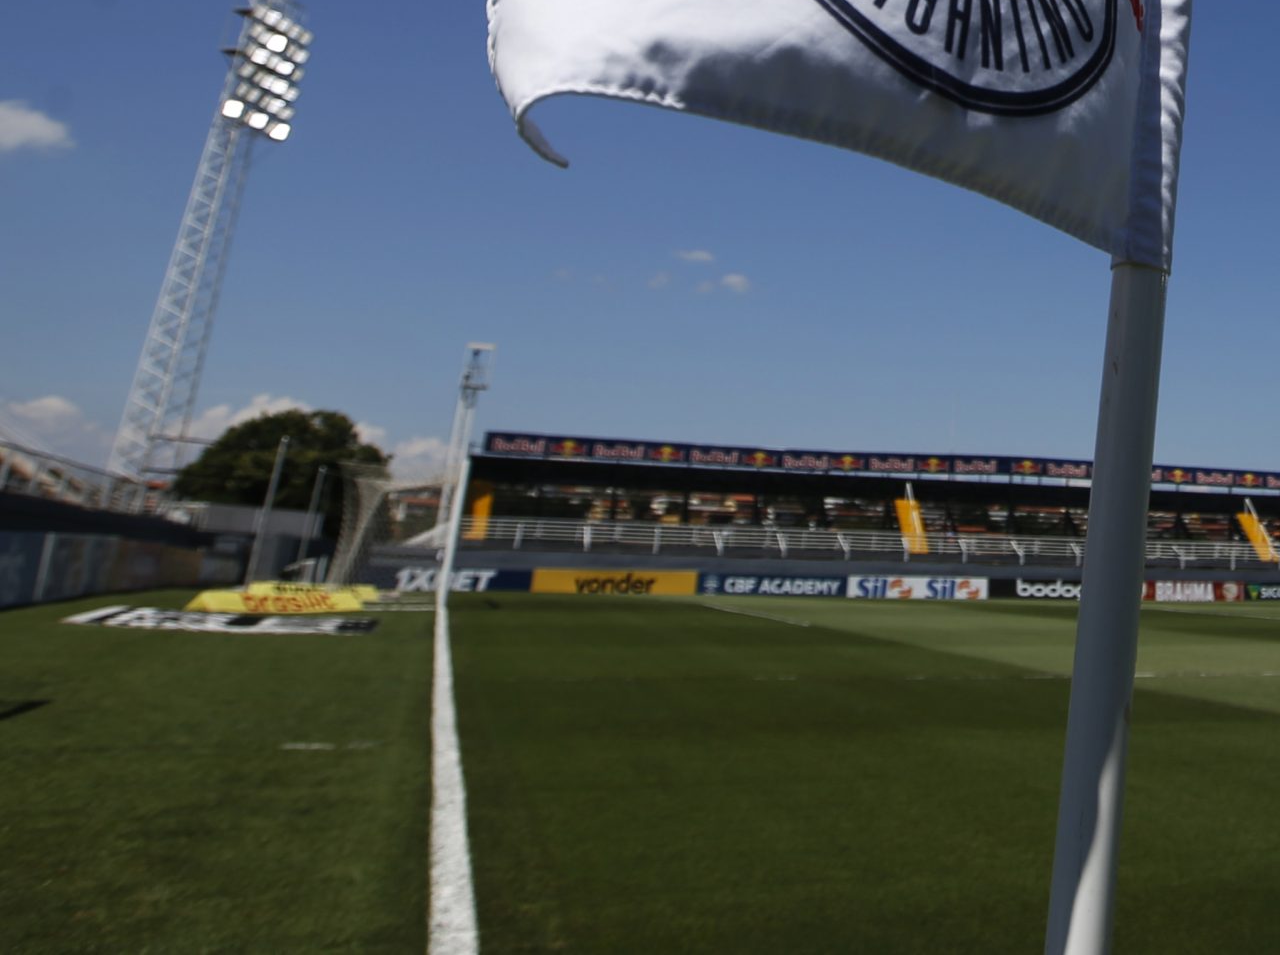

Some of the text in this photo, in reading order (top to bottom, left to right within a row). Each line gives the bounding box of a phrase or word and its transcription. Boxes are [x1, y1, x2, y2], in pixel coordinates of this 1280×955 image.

[724, 577, 840, 595] CBF ACADEMY
[1155, 581, 1214, 602] BRAHMA
